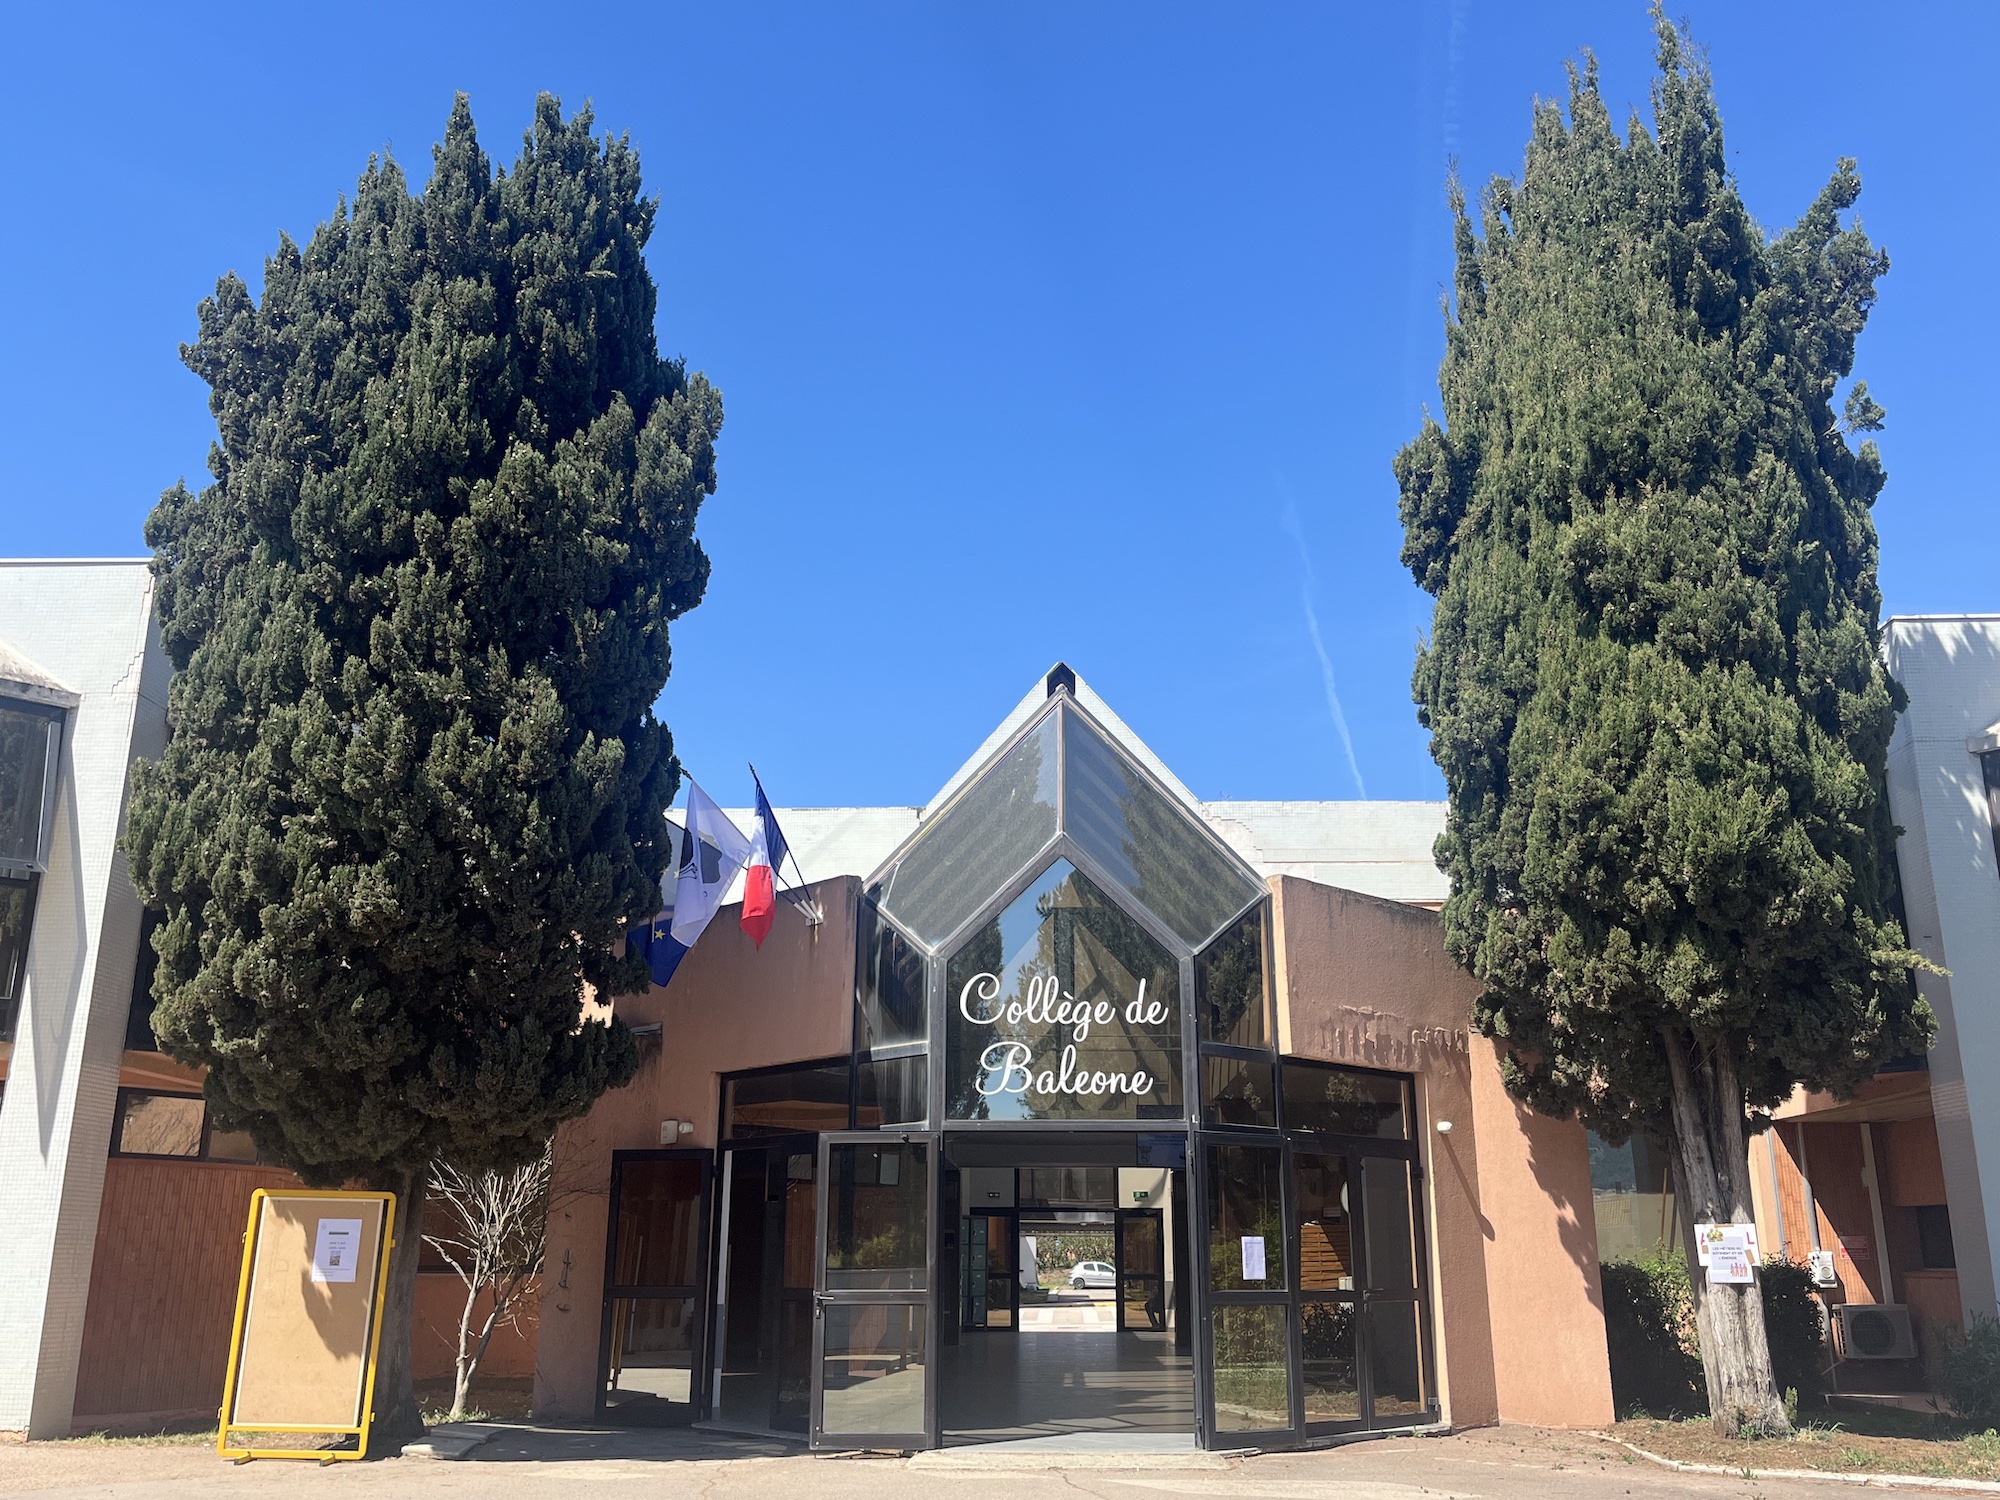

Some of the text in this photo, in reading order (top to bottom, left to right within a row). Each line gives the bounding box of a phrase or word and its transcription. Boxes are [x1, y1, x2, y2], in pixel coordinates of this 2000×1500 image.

[959, 972, 1169, 1042] Collège de
[975, 1041, 1154, 1096] Baleone
